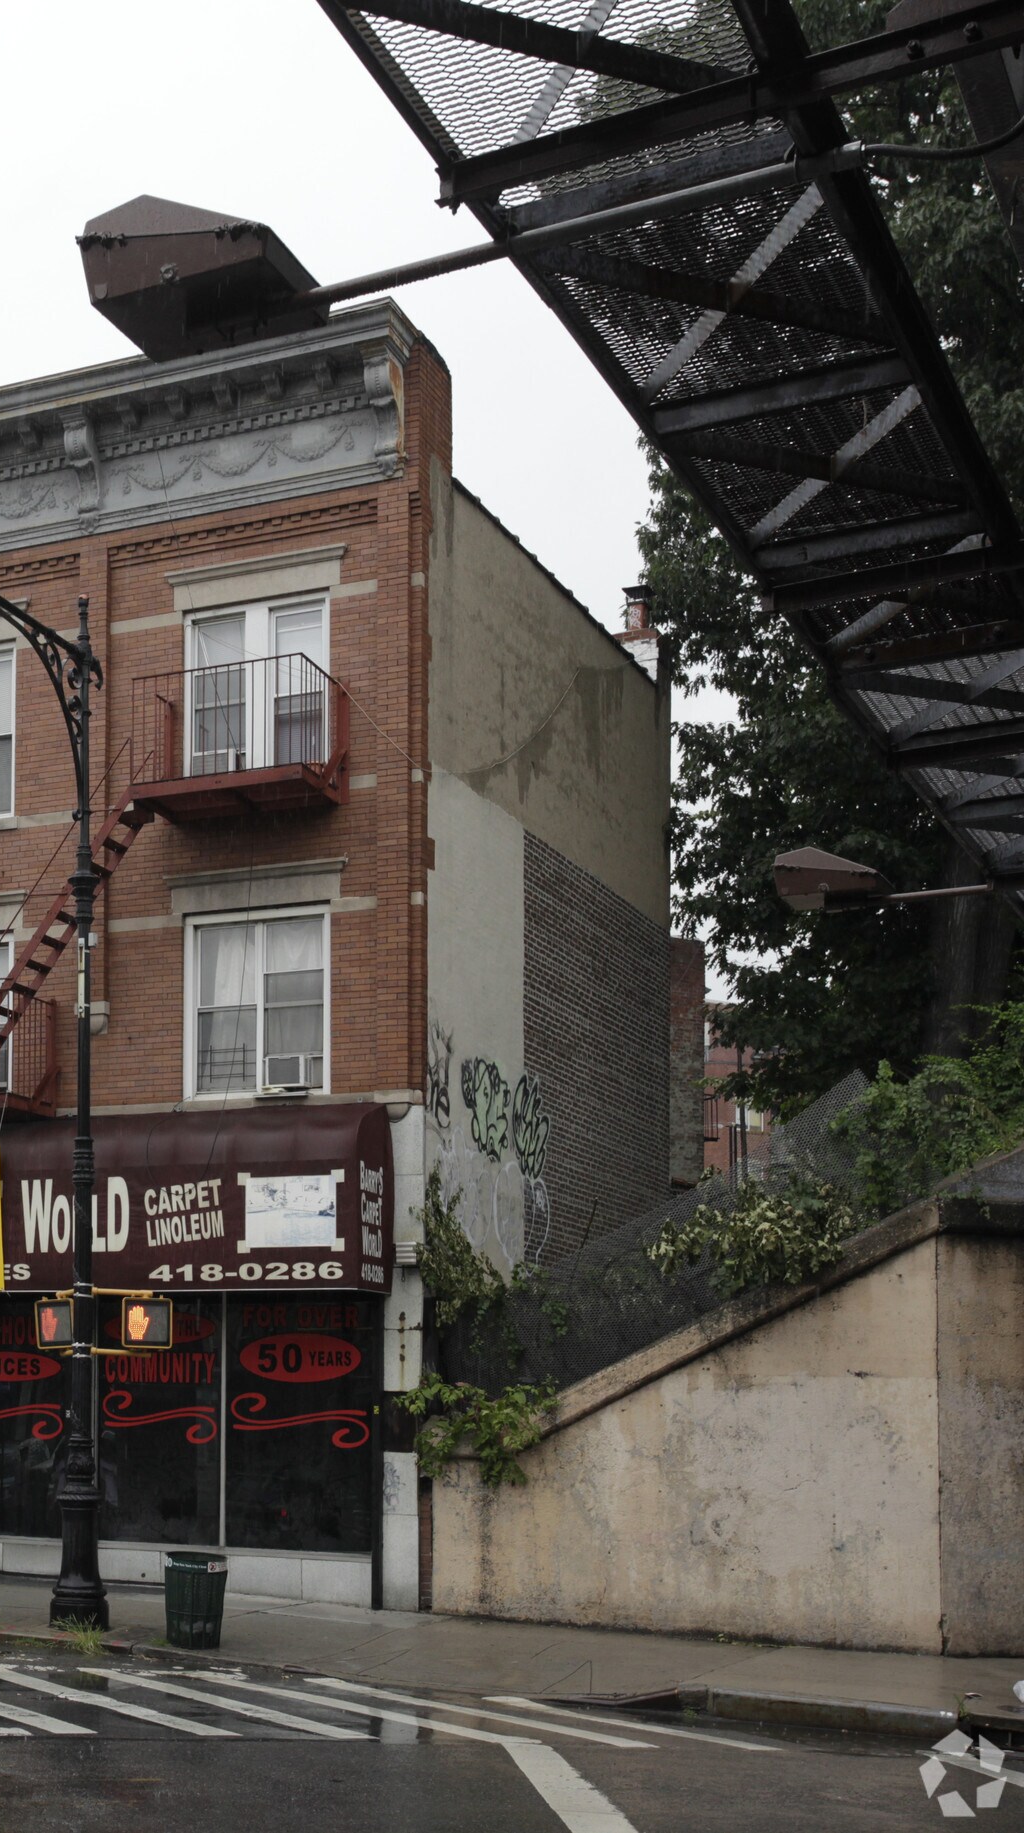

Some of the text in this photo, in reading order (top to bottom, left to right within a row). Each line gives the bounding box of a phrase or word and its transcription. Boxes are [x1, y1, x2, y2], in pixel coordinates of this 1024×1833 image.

[144, 1178, 222, 1216] CARPET
[361, 1192, 383, 1226] CARPET
[21, 1176, 129, 1254] WOLD
[146, 1210, 224, 1247] LINOLEUM
[361, 1225, 383, 1258] WORLD
[148, 1261, 344, 1282] 418-0286
[243, 1305, 360, 1328] FOR OVER
[105, 1352, 216, 1384] COMMUNITY
[257, 1342, 352, 1373] 50 YEARS
